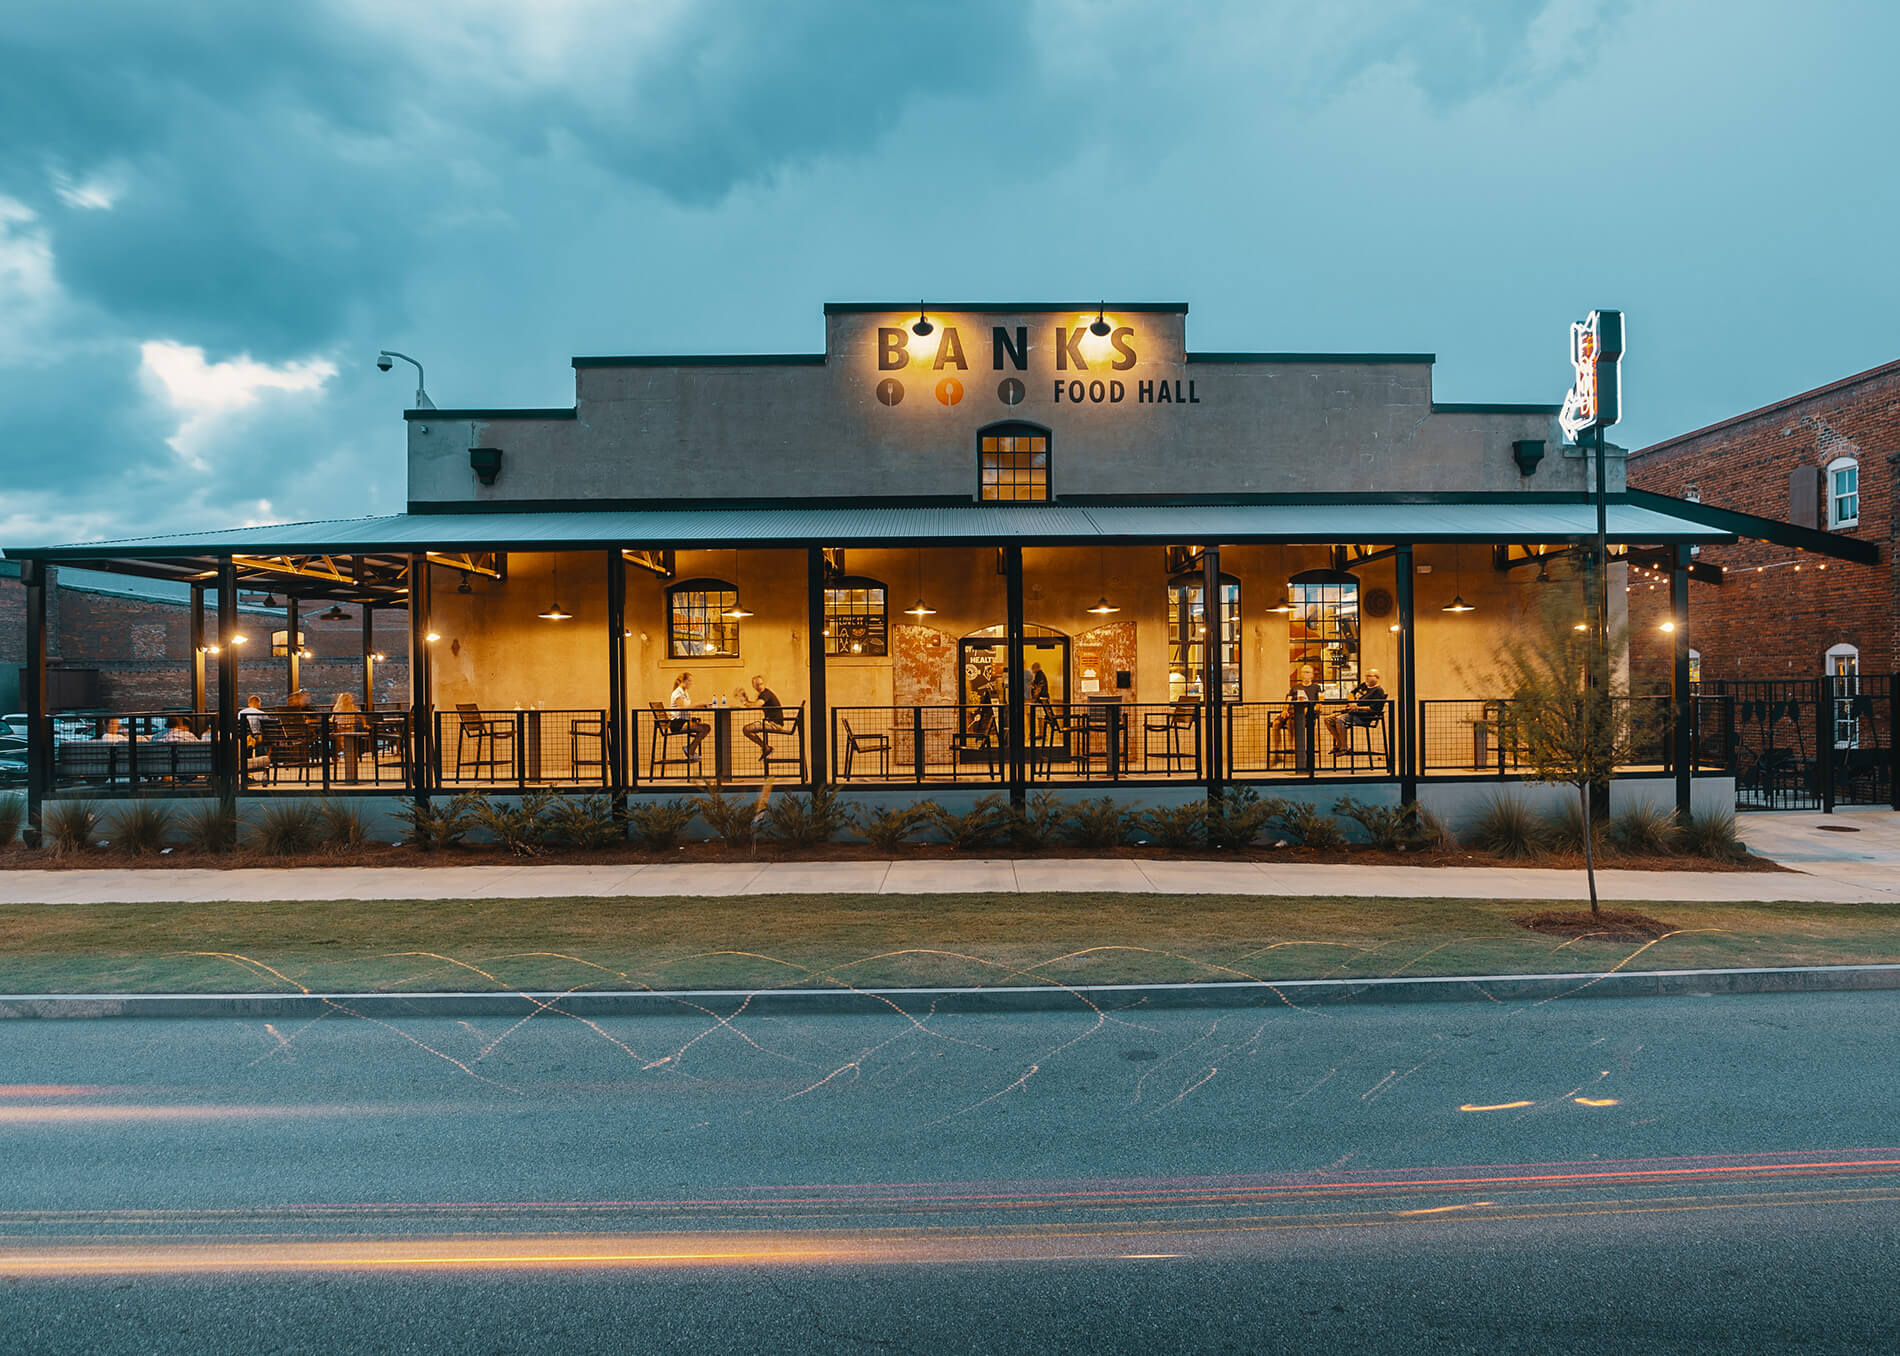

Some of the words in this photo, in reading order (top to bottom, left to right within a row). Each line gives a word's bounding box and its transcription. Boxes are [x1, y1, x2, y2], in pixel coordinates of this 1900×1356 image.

[877, 326, 1138, 371] BANKS
[1054, 379, 1126, 404] FOOD
[1138, 379, 1201, 404] HALL
